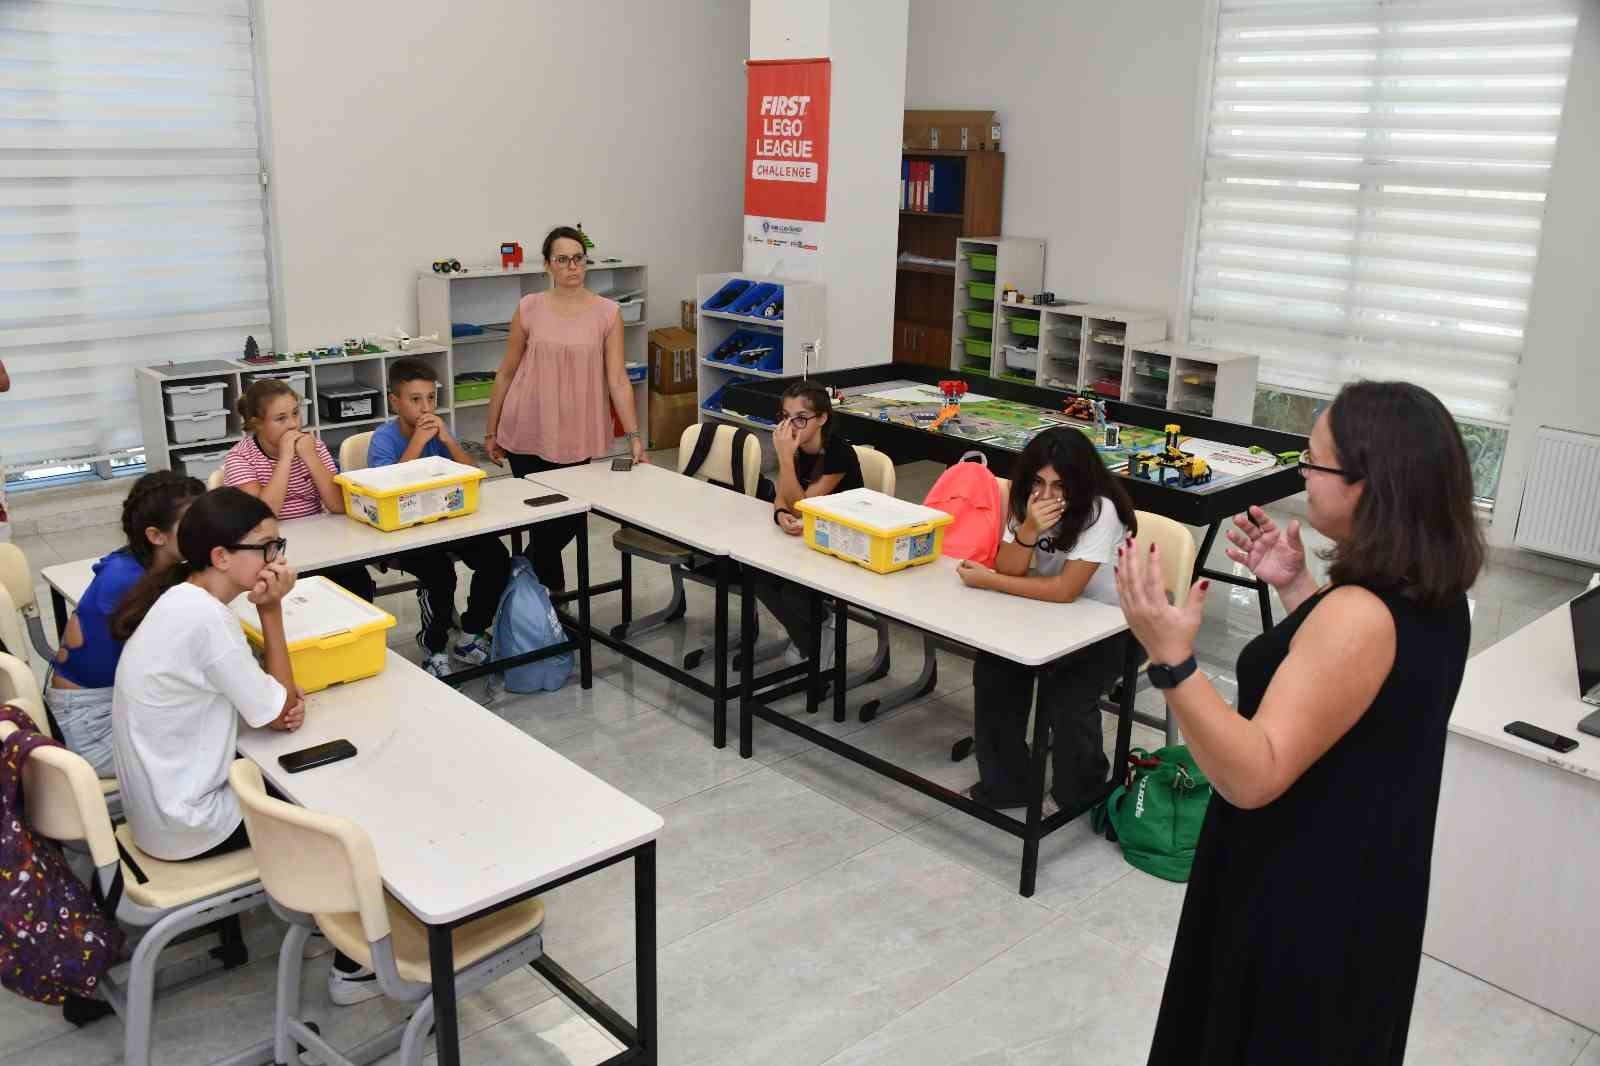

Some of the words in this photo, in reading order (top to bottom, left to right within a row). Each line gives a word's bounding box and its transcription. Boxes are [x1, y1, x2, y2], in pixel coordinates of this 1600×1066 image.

[760, 96, 810, 115] FIRST
[763, 119, 802, 136] LEGO
[756, 139, 812, 158] LEAGUE
[756, 164, 812, 178] CHALLENGE
